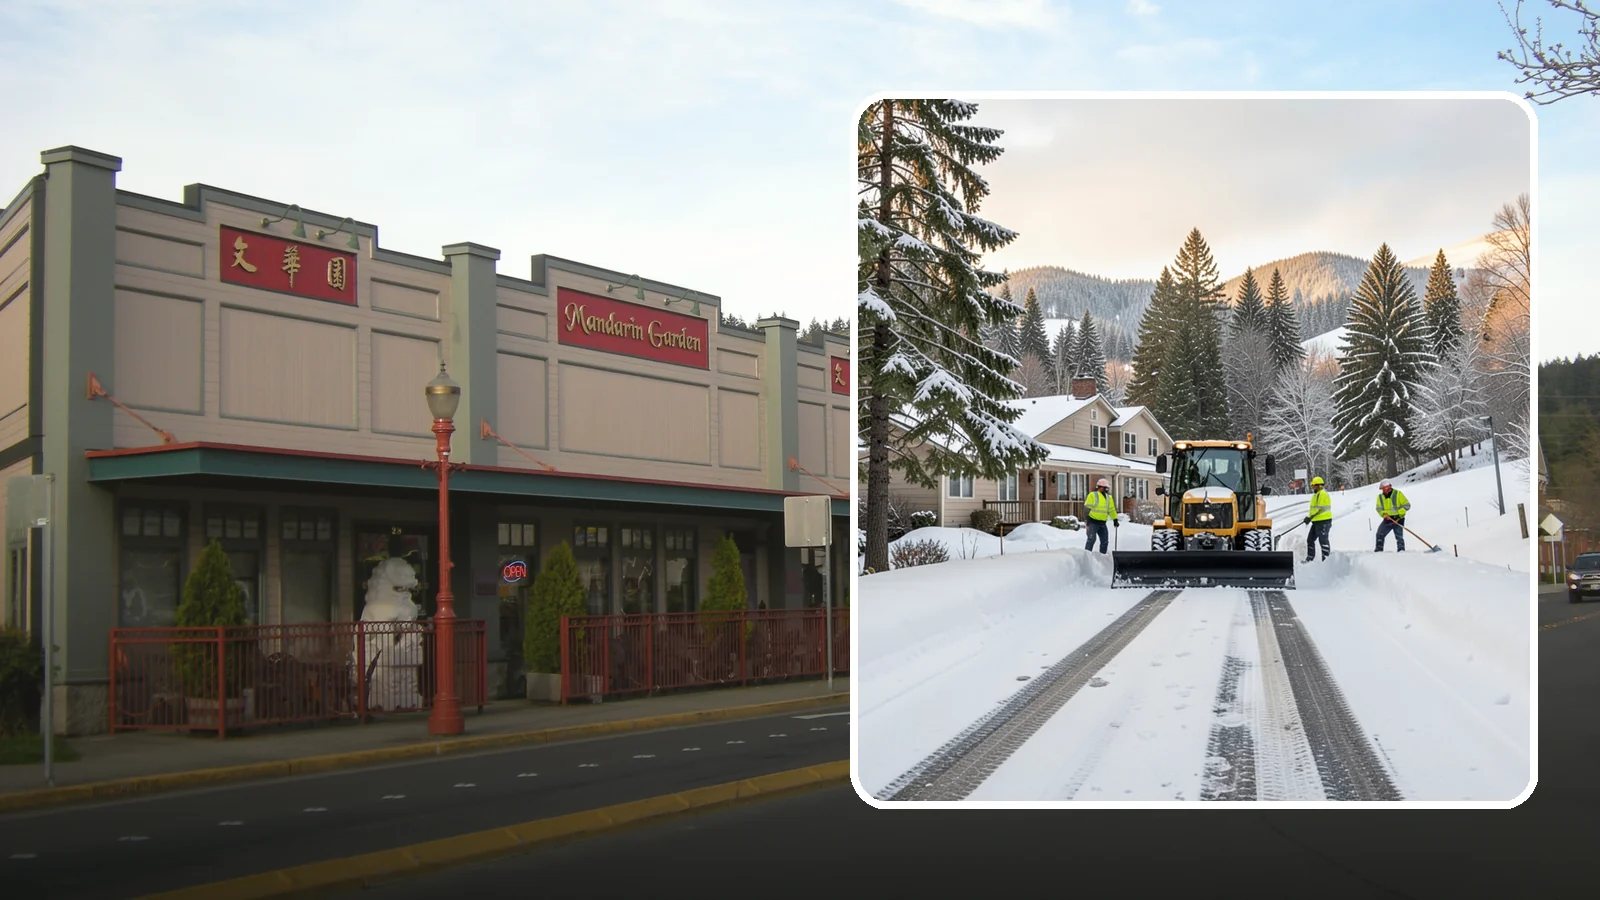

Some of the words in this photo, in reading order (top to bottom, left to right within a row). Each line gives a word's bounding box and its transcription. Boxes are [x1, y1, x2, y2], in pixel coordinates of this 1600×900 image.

[231, 235, 346, 290] 文華園
[564, 302, 643, 341] Mandarin
[648, 320, 701, 352] Garden
[835, 362, 847, 386] 文
[503, 566, 526, 578] OPEN
